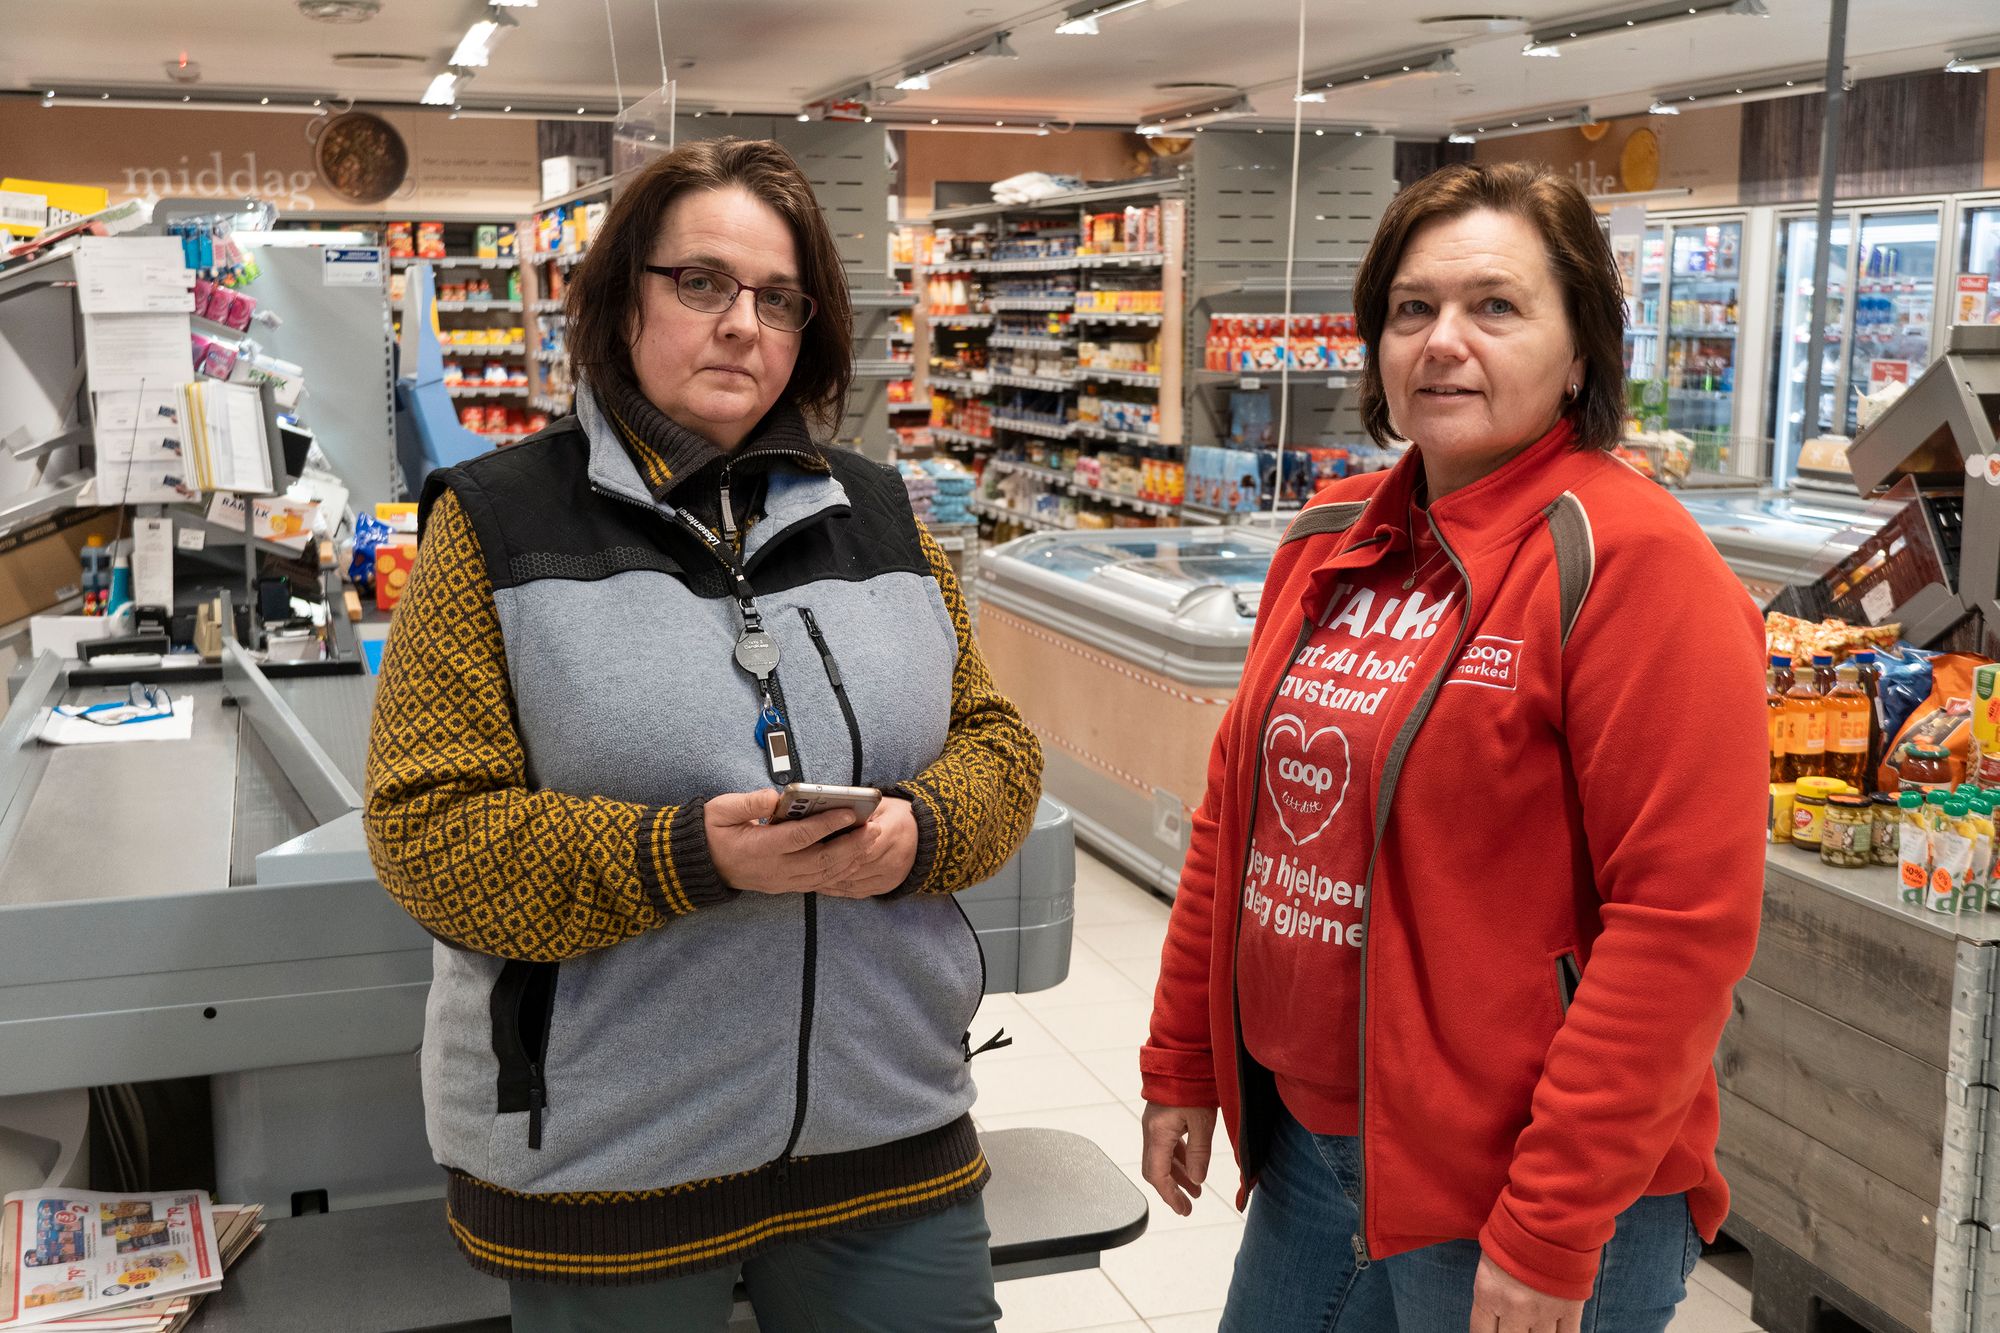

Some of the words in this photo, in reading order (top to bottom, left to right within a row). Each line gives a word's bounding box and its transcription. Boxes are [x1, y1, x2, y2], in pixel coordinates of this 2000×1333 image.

[121, 152, 317, 212] middag
[1294, 643, 1327, 668] at
[1320, 648, 1359, 675] du
[1279, 674, 1389, 715] avstand
[1278, 757, 1333, 795] coop
[1246, 838, 1274, 886] jeg
[1275, 853, 1366, 909] hjelper
[1244, 880, 1273, 927] deg
[1273, 898, 1363, 948] gjerne
